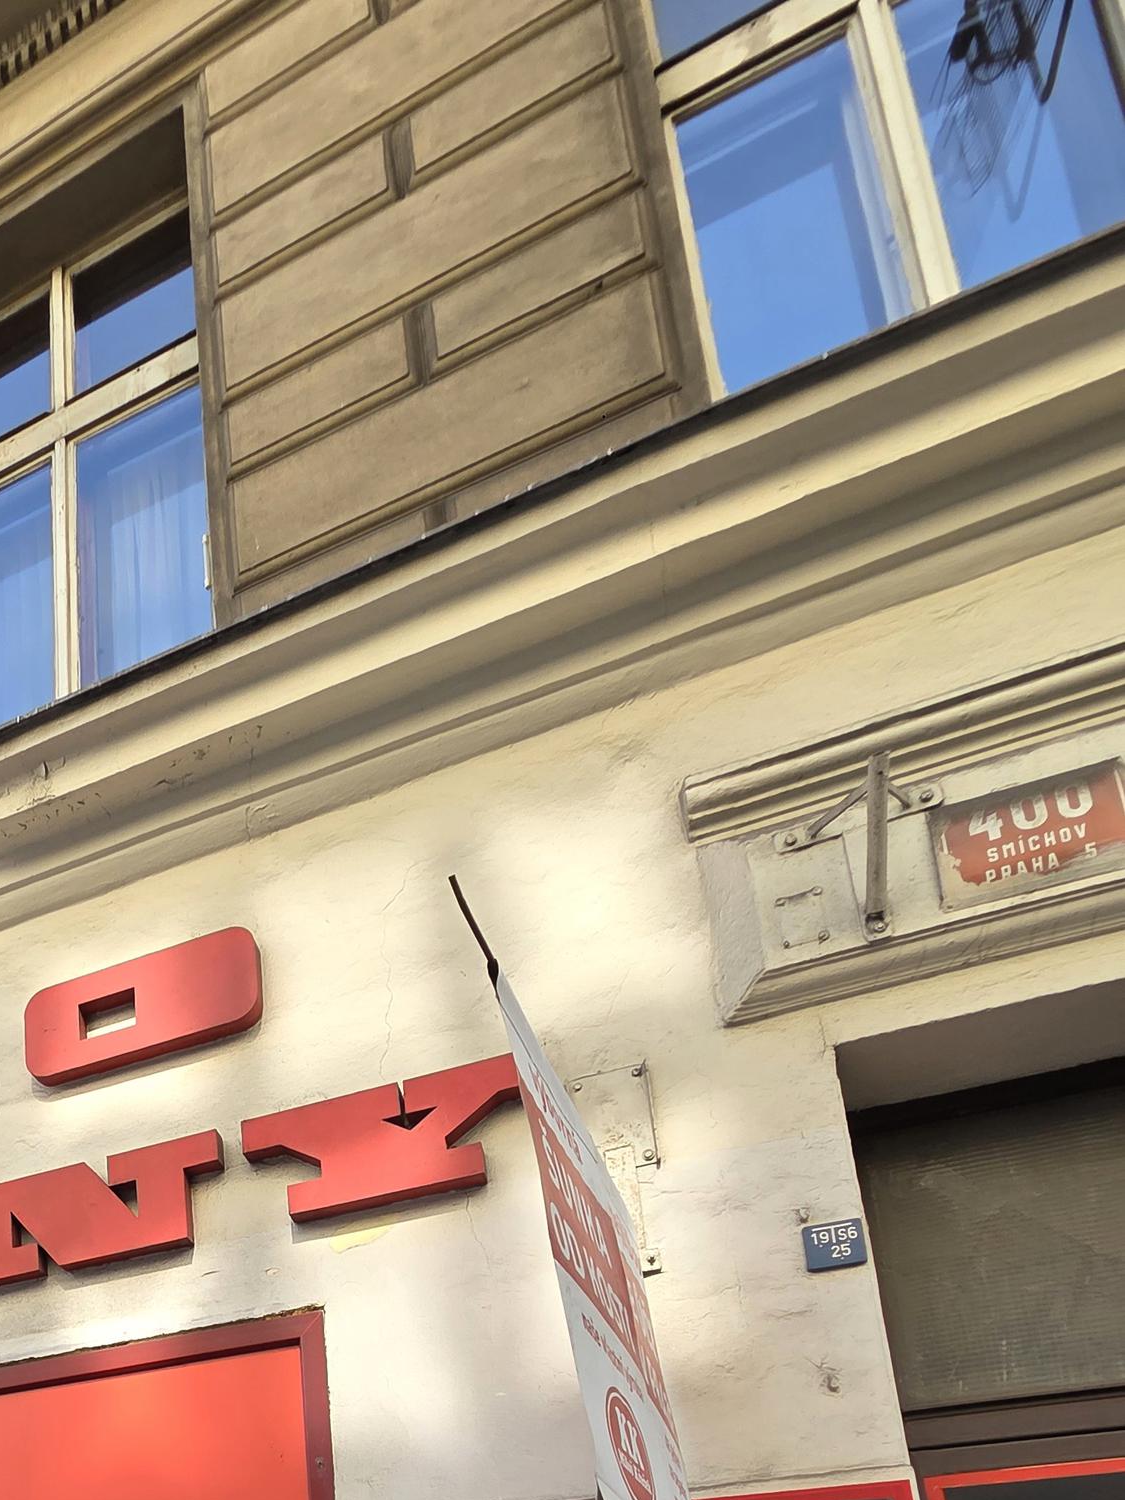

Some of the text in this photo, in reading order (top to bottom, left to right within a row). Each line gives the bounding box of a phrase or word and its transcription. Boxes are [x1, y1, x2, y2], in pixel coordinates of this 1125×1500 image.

[985, 841, 1098, 883] PRAHA 5
[986, 823, 1086, 863] SMÍCHOV
[538, 1117, 613, 1269] ŠUNKA
[550, 1201, 586, 1281] OD
[831, 1243, 852, 1258] 25
[615, 1406, 645, 1471] KK
